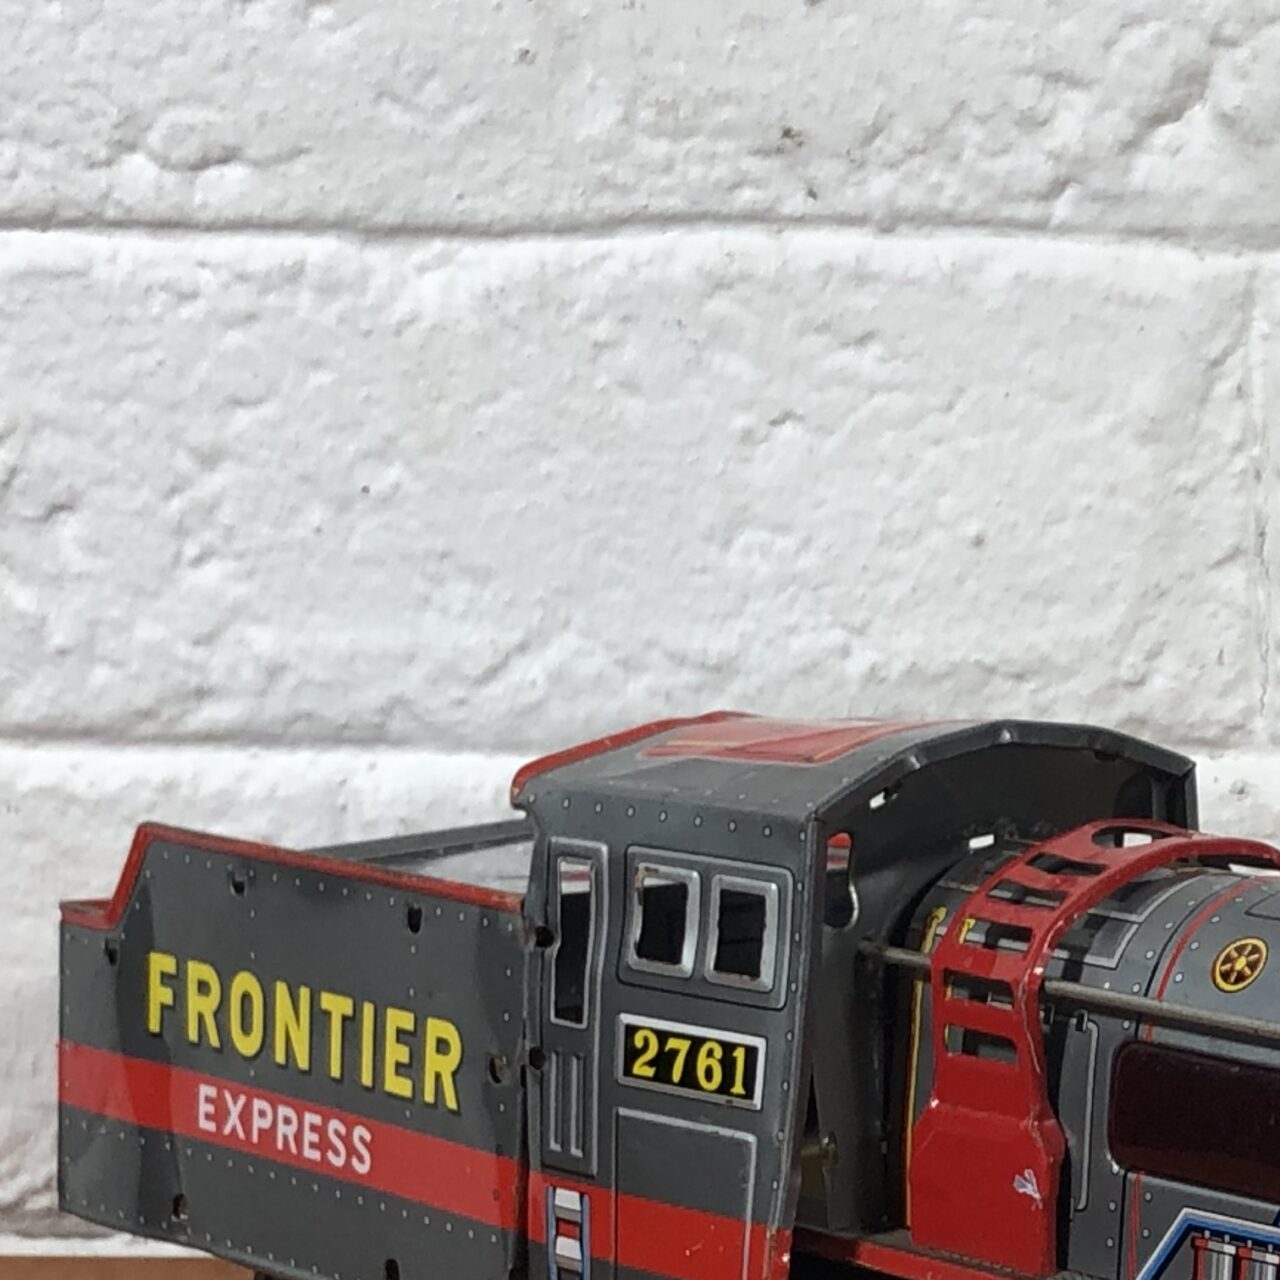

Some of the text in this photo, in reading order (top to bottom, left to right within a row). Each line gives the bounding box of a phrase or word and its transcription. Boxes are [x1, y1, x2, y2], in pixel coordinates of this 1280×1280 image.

[147, 951, 463, 1111] FRONTIER
[632, 1029, 746, 1095] 2761
[198, 1084, 373, 1175] EXPRESS
